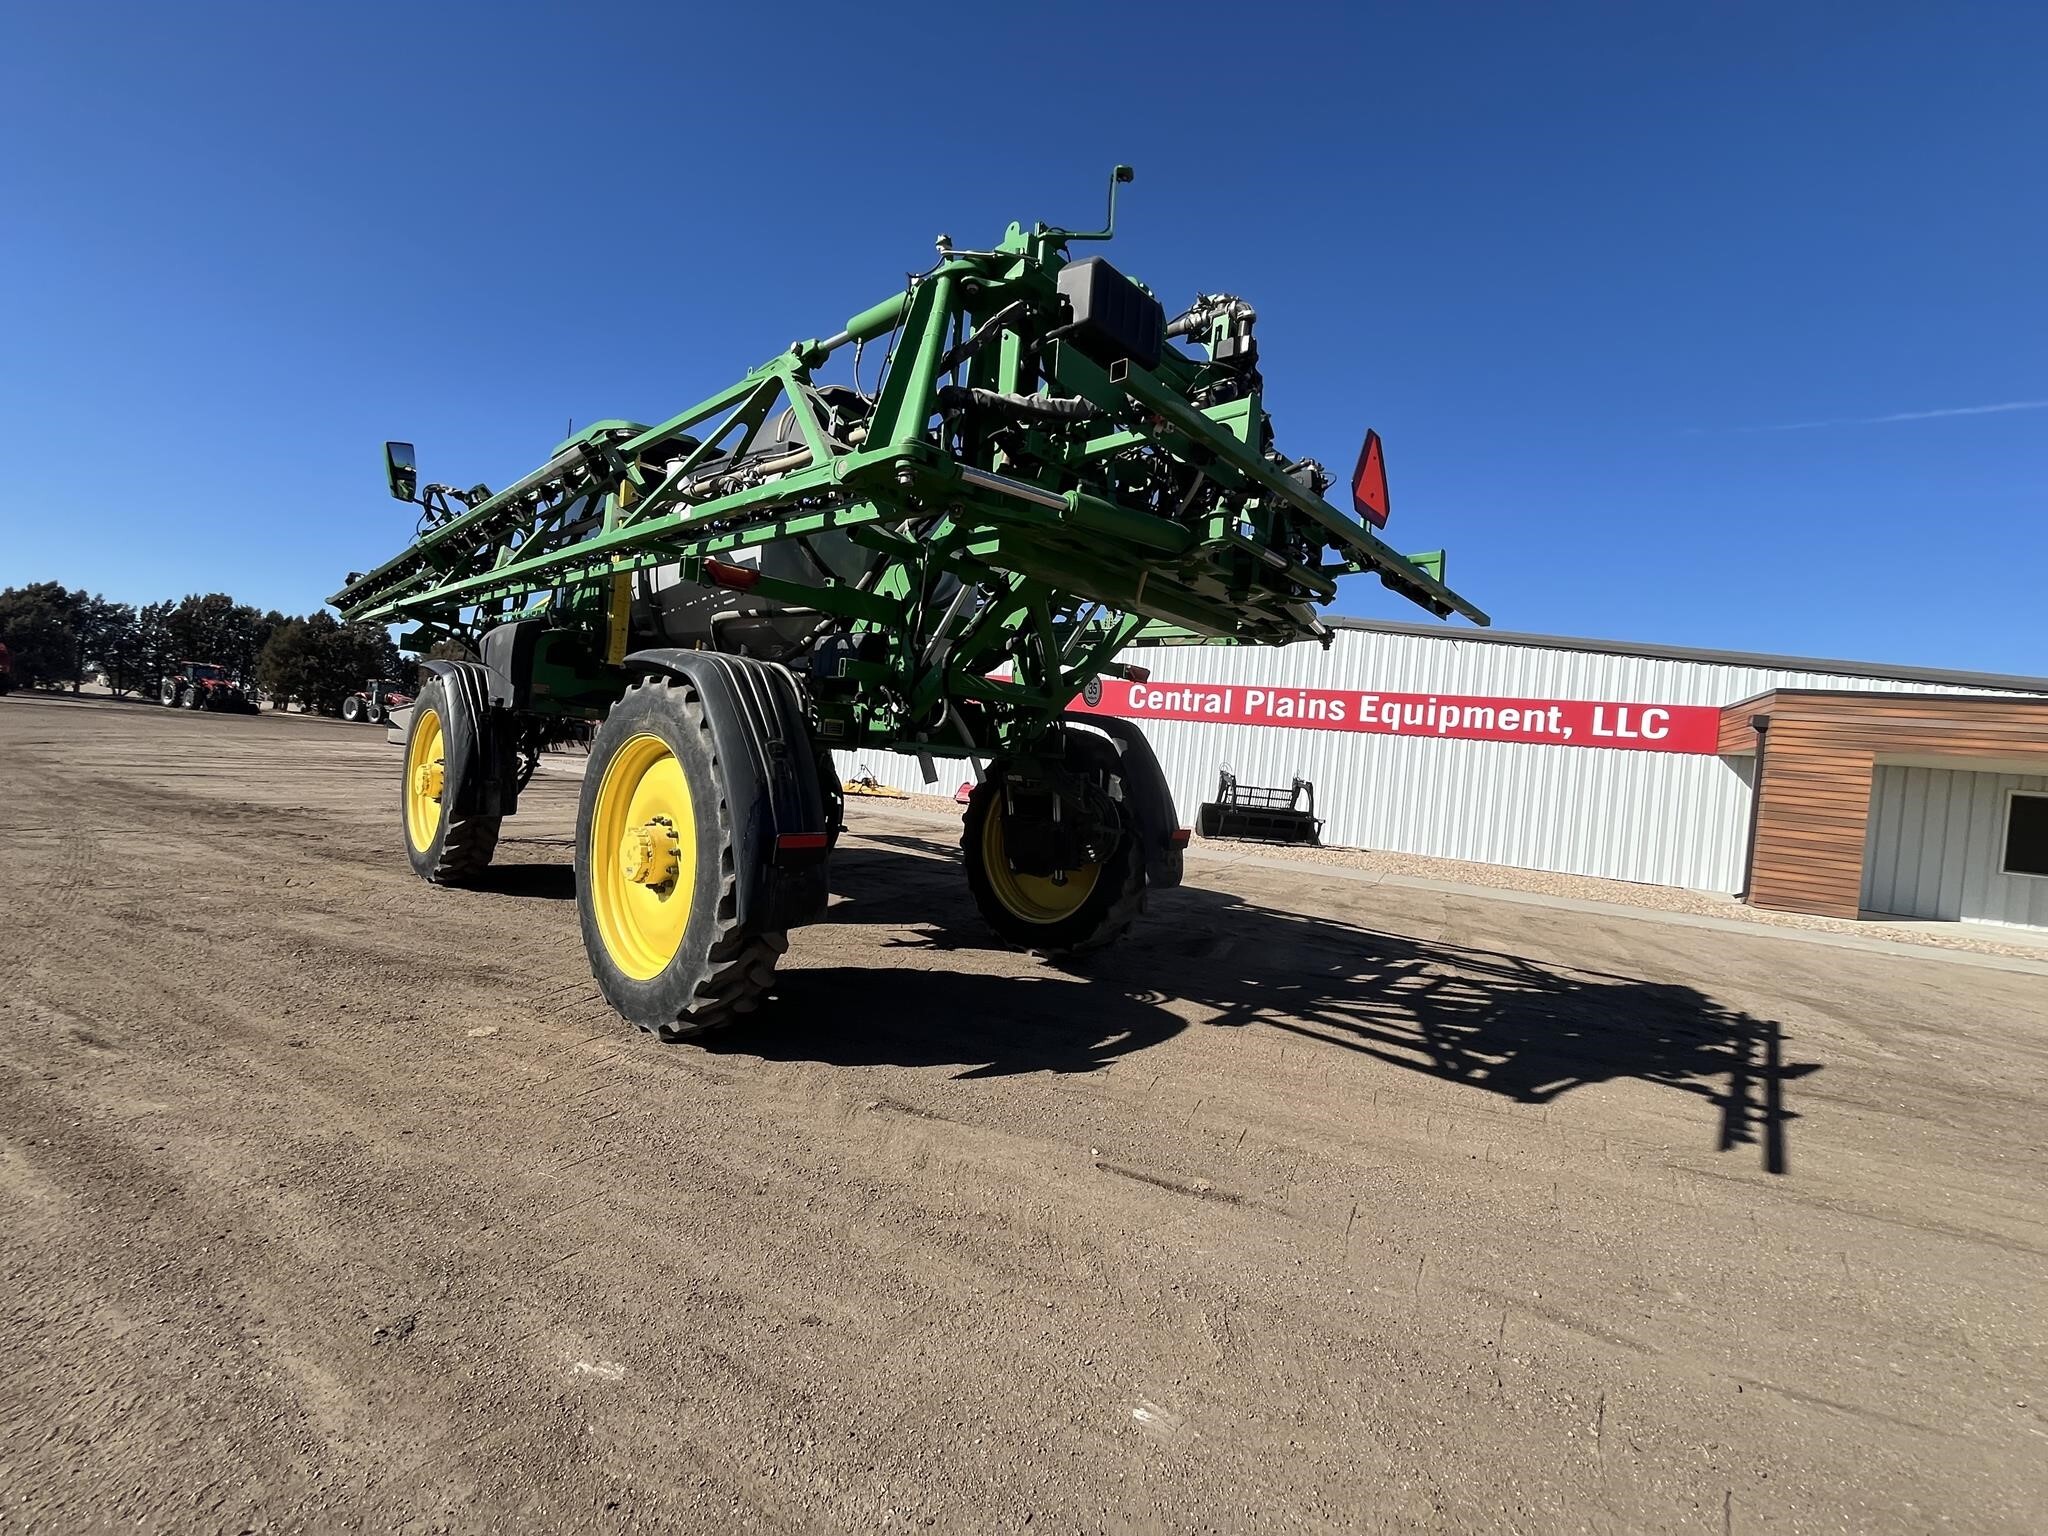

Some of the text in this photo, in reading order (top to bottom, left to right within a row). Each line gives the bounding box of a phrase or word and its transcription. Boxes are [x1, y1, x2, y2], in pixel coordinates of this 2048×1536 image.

[1087, 683, 1098, 695] 35
[1127, 683, 1670, 740] Central Plains Equipment, LLC
